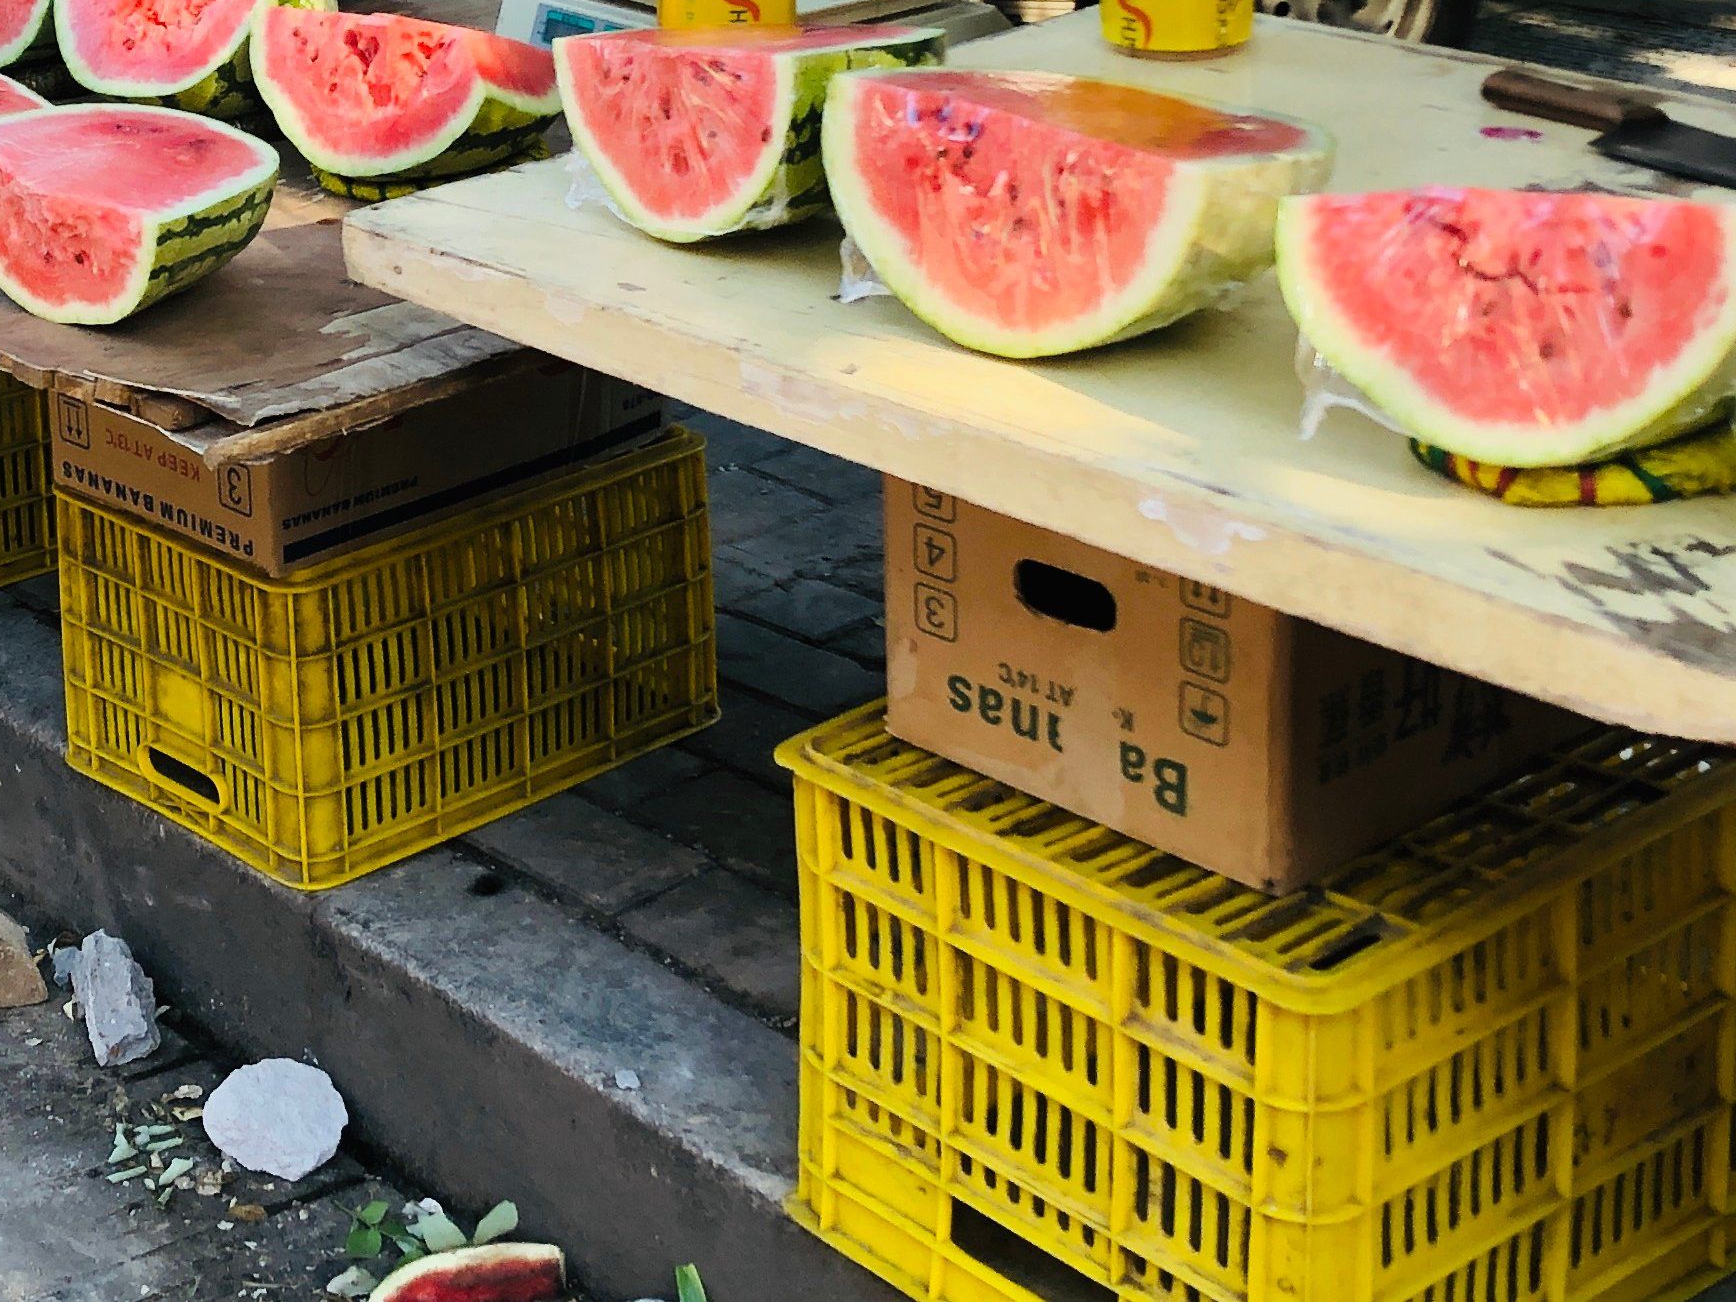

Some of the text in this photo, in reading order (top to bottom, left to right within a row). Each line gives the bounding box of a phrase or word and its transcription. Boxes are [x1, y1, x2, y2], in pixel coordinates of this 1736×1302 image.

[132, 440, 153, 461] AT
[156, 452, 201, 483] KEEP
[226, 466, 243, 506] 3
[61, 460, 254, 557] PREMIUM BANANAS
[281, 496, 353, 531] BANANAS
[924, 535, 946, 569] 4
[925, 596, 946, 629] 3
